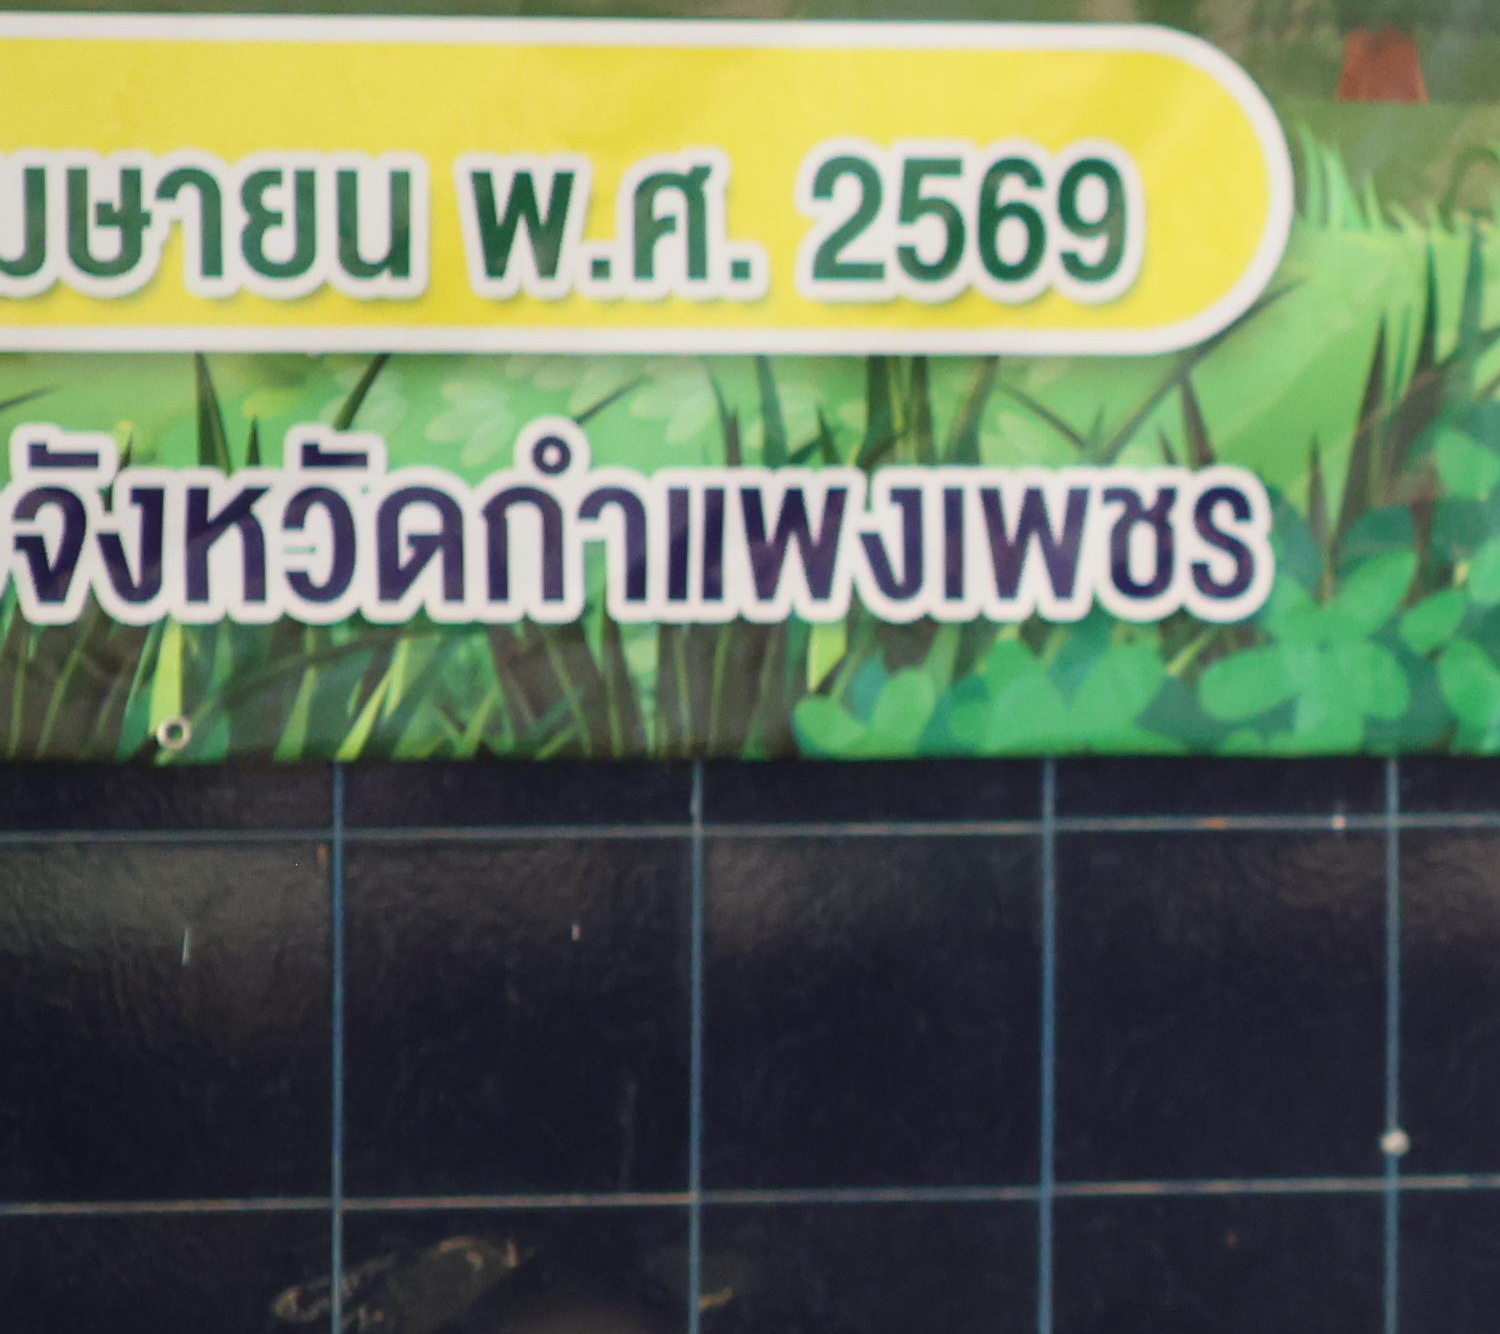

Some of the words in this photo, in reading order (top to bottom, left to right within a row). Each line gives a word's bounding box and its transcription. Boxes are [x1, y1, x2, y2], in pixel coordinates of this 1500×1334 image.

[470, 165, 751, 280] พ.ศ.
[811, 155, 1127, 282] 2569
[12, 435, 1255, 602] จังหวัดกำแพงเพชร
